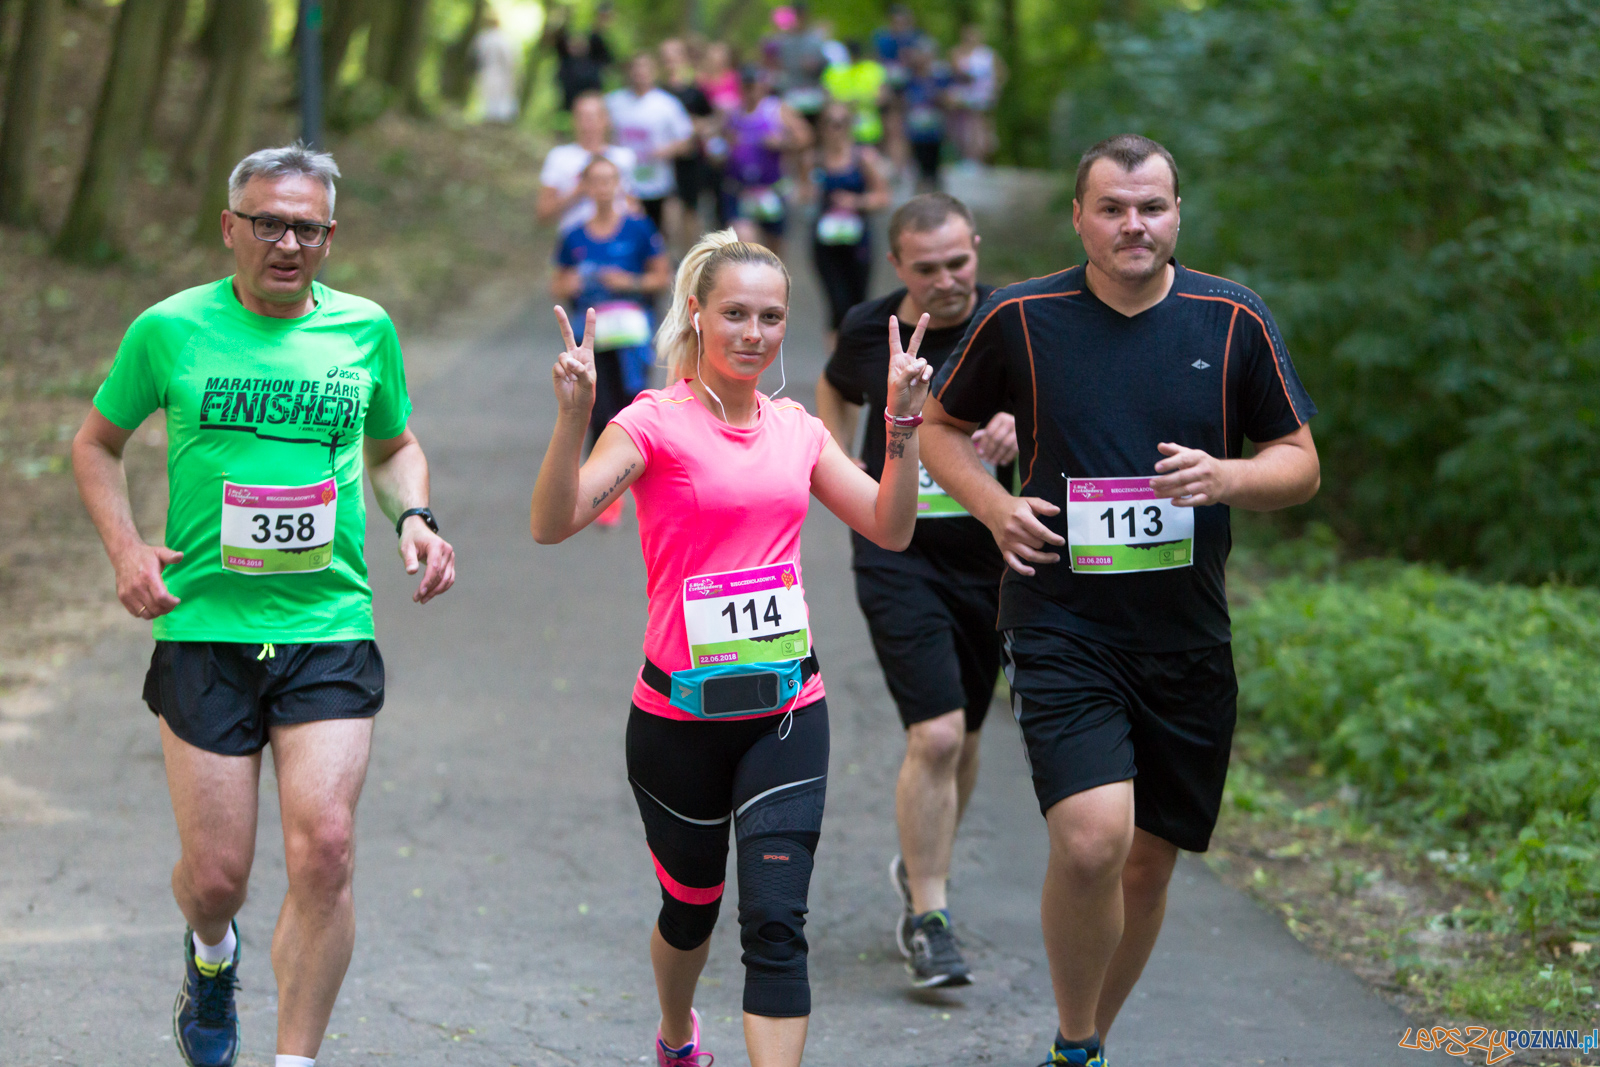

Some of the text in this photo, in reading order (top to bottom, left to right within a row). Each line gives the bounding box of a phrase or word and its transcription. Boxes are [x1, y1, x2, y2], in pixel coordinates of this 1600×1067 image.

[339, 369, 360, 380] asics
[205, 377, 360, 399] MARATHON DE PARIS
[200, 391, 360, 429] FINISHER!
[251, 513, 315, 543] 358
[1100, 505, 1163, 538] 113
[229, 556, 262, 567] 22.06.2018
[721, 595, 782, 634] 114
[700, 653, 737, 663] 22.06.2018
